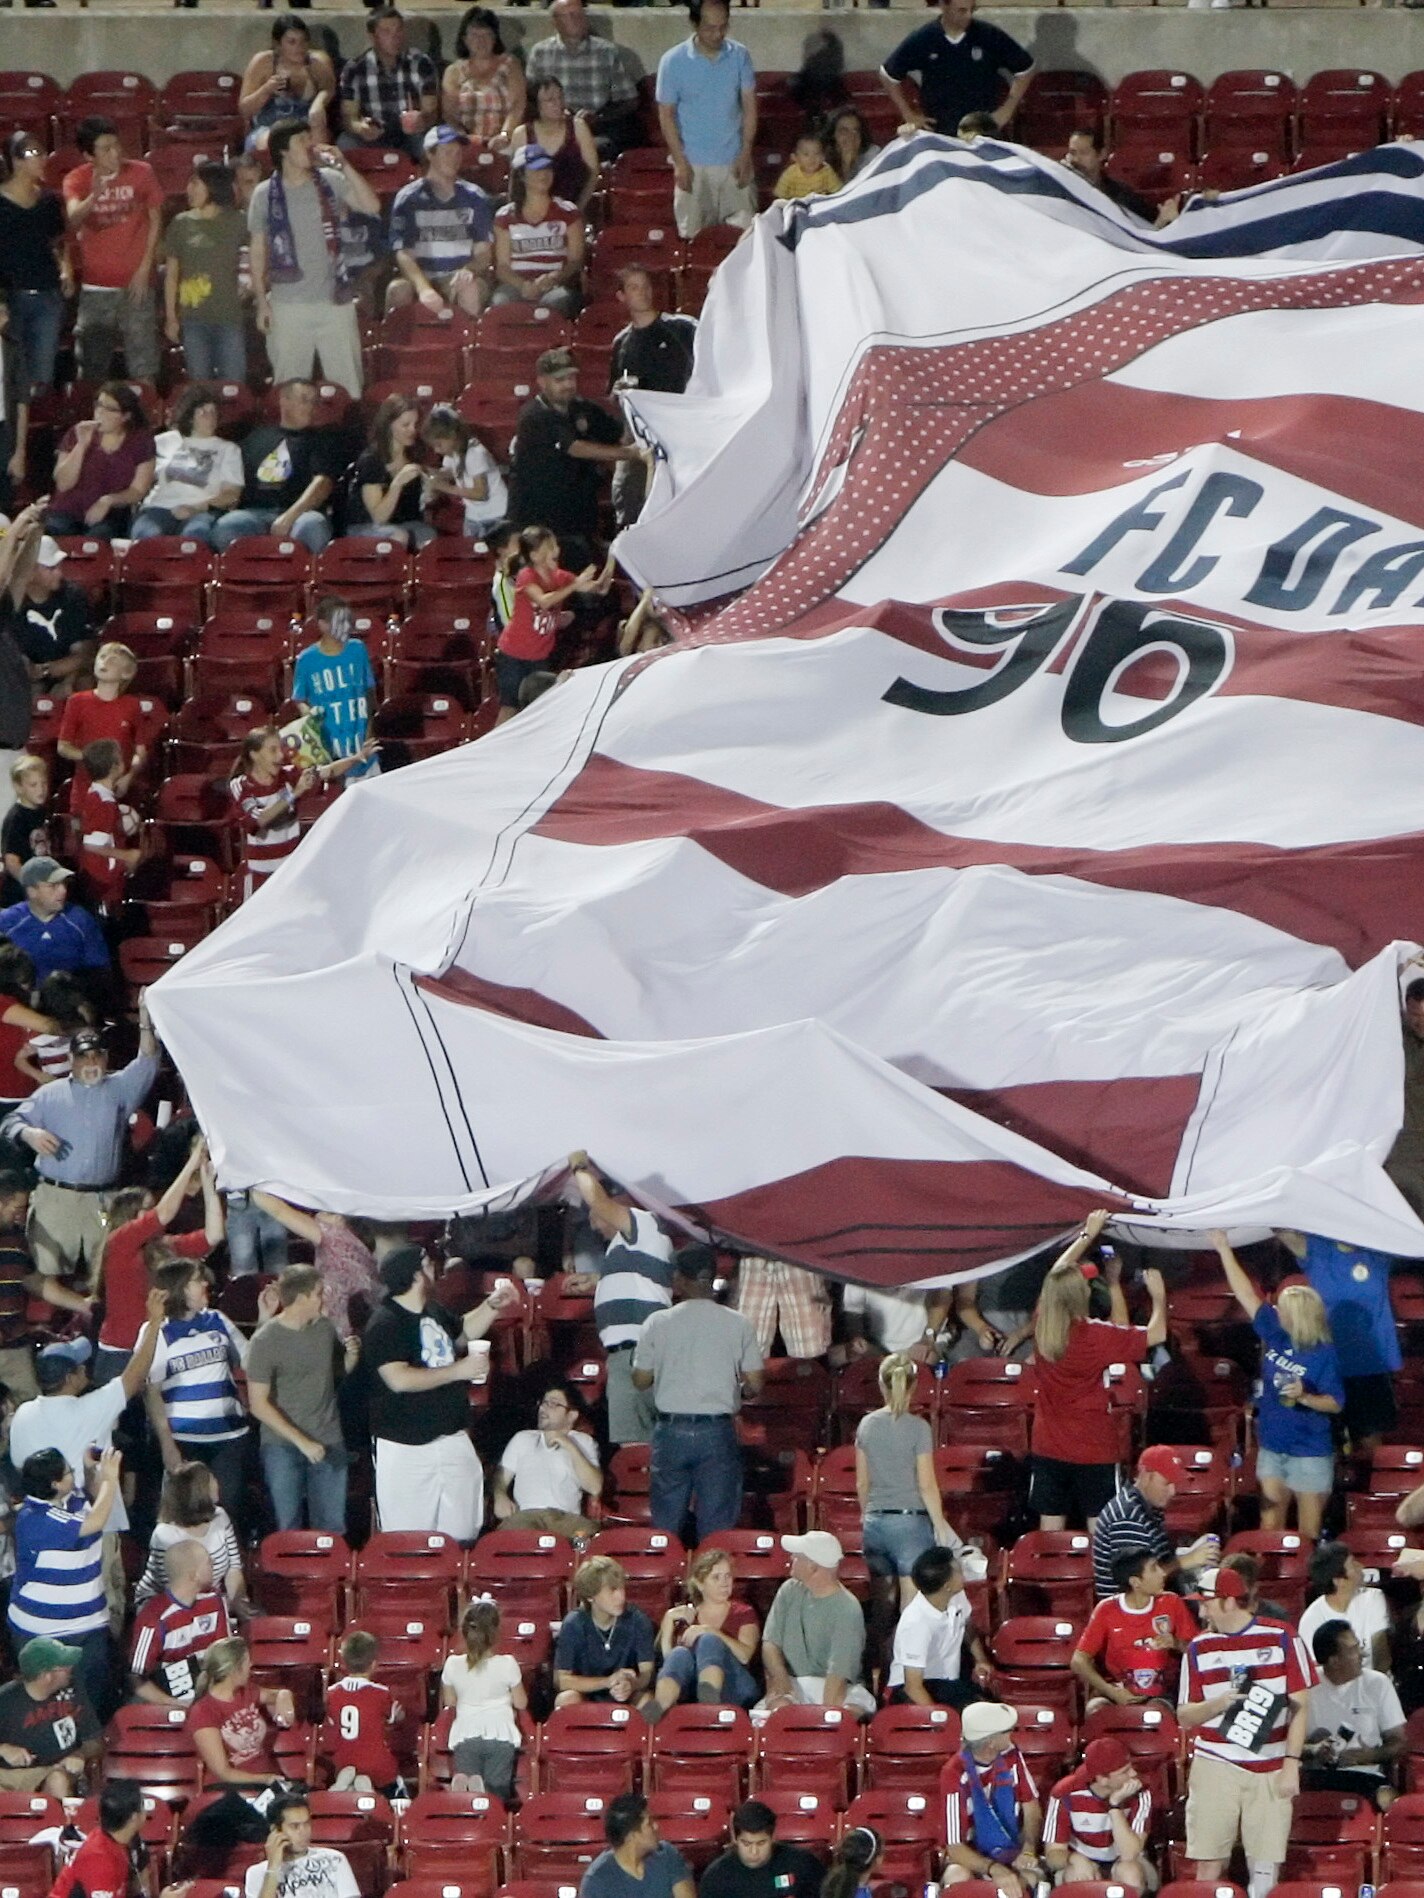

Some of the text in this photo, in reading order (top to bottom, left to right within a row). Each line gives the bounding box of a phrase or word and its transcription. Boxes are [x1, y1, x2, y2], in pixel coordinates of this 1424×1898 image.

[1058, 468, 1264, 594] FC
[880, 592, 1235, 744] 96
[340, 1705, 360, 1740] 9
[1226, 1685, 1275, 1749] BR19
